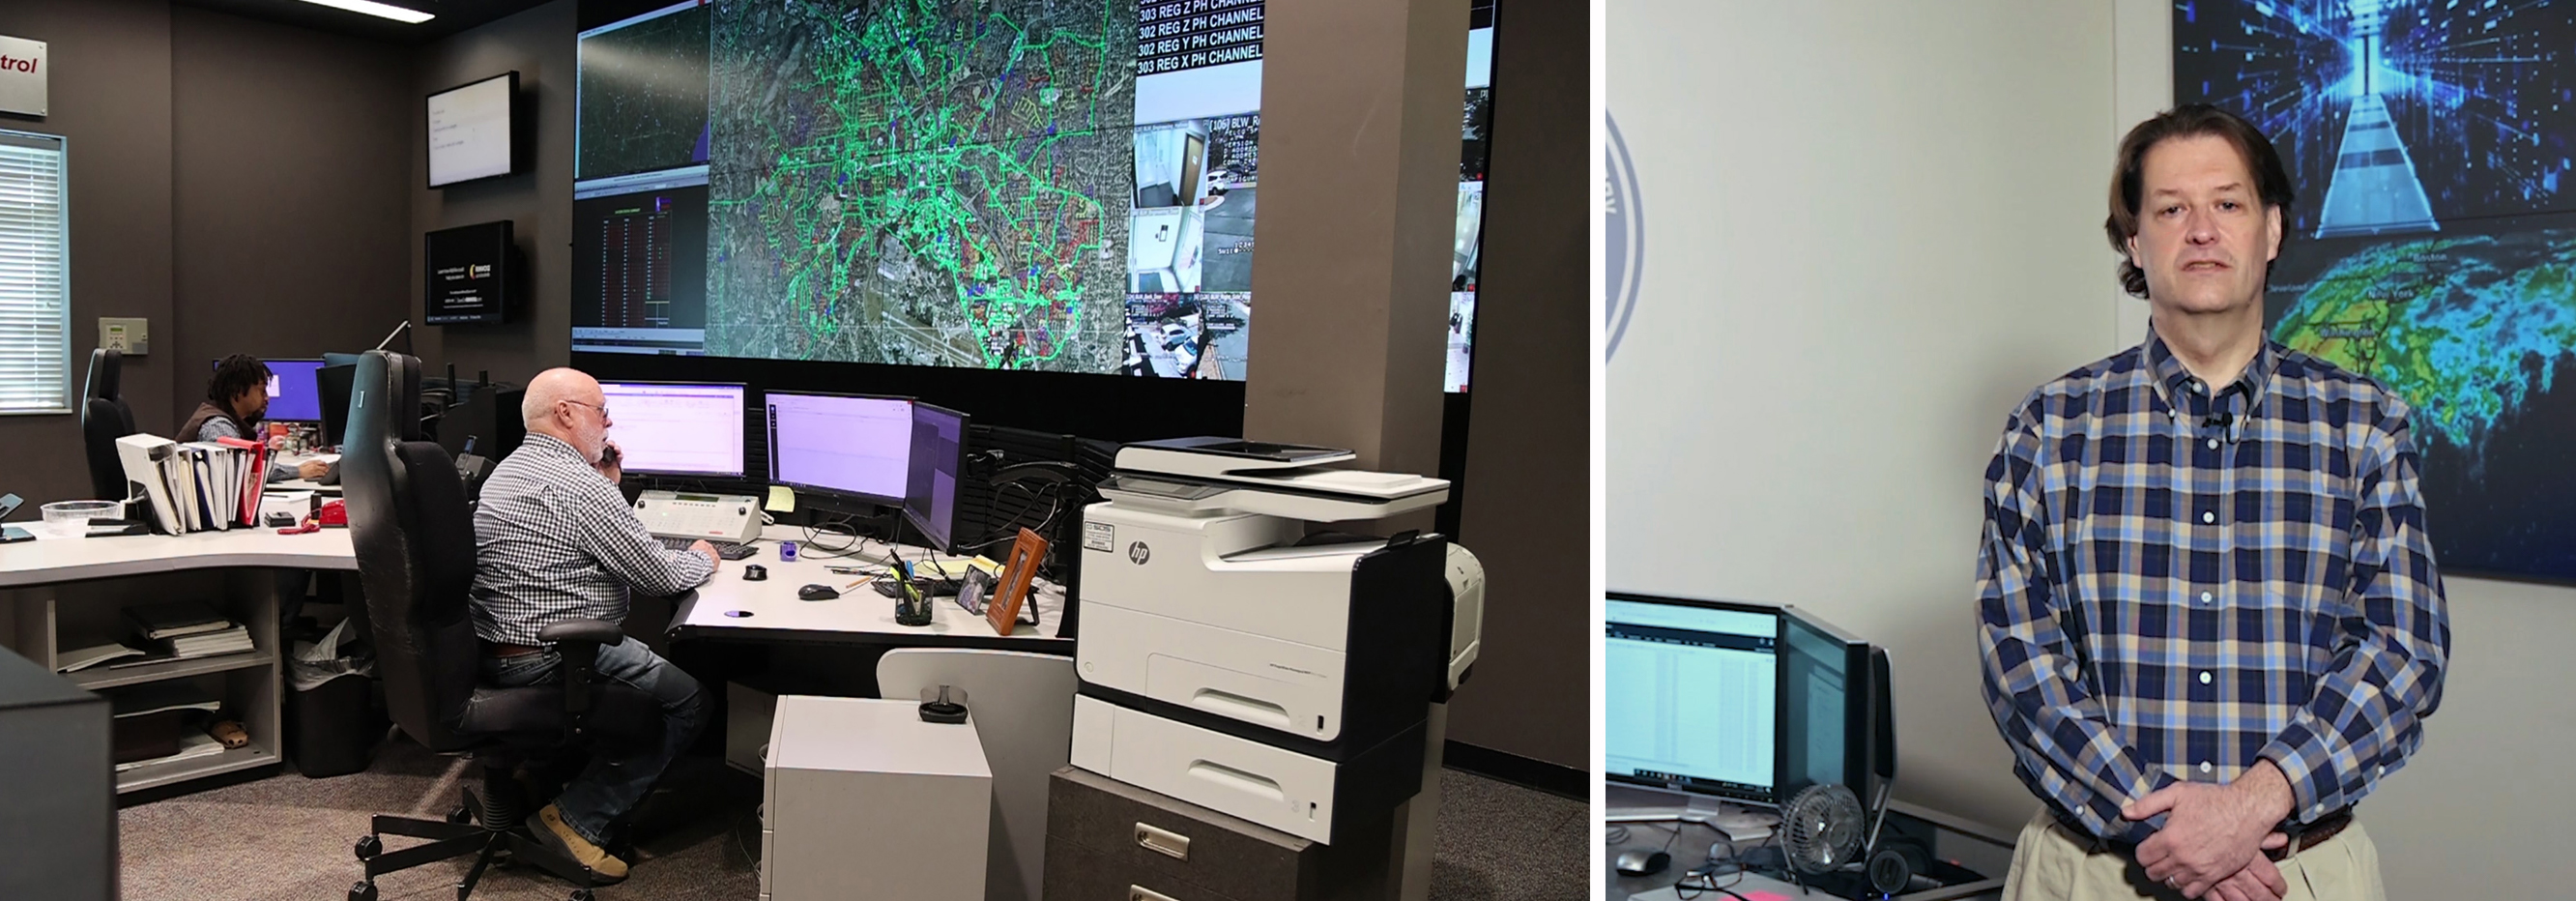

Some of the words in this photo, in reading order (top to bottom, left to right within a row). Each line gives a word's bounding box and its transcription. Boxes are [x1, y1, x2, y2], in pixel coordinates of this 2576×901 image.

[1140, 8, 1157, 22] 303
[1159, 3, 1181, 18] REG
[1183, 1, 1191, 15] Z
[1193, 0, 1208, 13] PH
[1139, 25, 1156, 40] 302
[1158, 20, 1180, 37] REG
[1182, 18, 1190, 33] Z
[1192, 15, 1207, 31] PH
[1209, 7, 1263, 28] CHANNEL
[1138, 43, 1155, 57] 302
[1157, 39, 1179, 54] REG
[1182, 37, 1190, 50] Y
[1192, 34, 1207, 48] PH
[1209, 25, 1263, 45] CHANNEL
[0, 54, 38, 74] trol
[1137, 60, 1154, 74] 303
[1156, 56, 1179, 72] REG
[1181, 54, 1189, 69] X
[1191, 52, 1206, 67] PH
[1208, 44, 1263, 64] CHANNEL
[2413, 253, 2447, 262] Boston
[2392, 289, 2415, 298] York
[2321, 328, 2376, 338] Washington
[1129, 540, 1150, 566] hp
